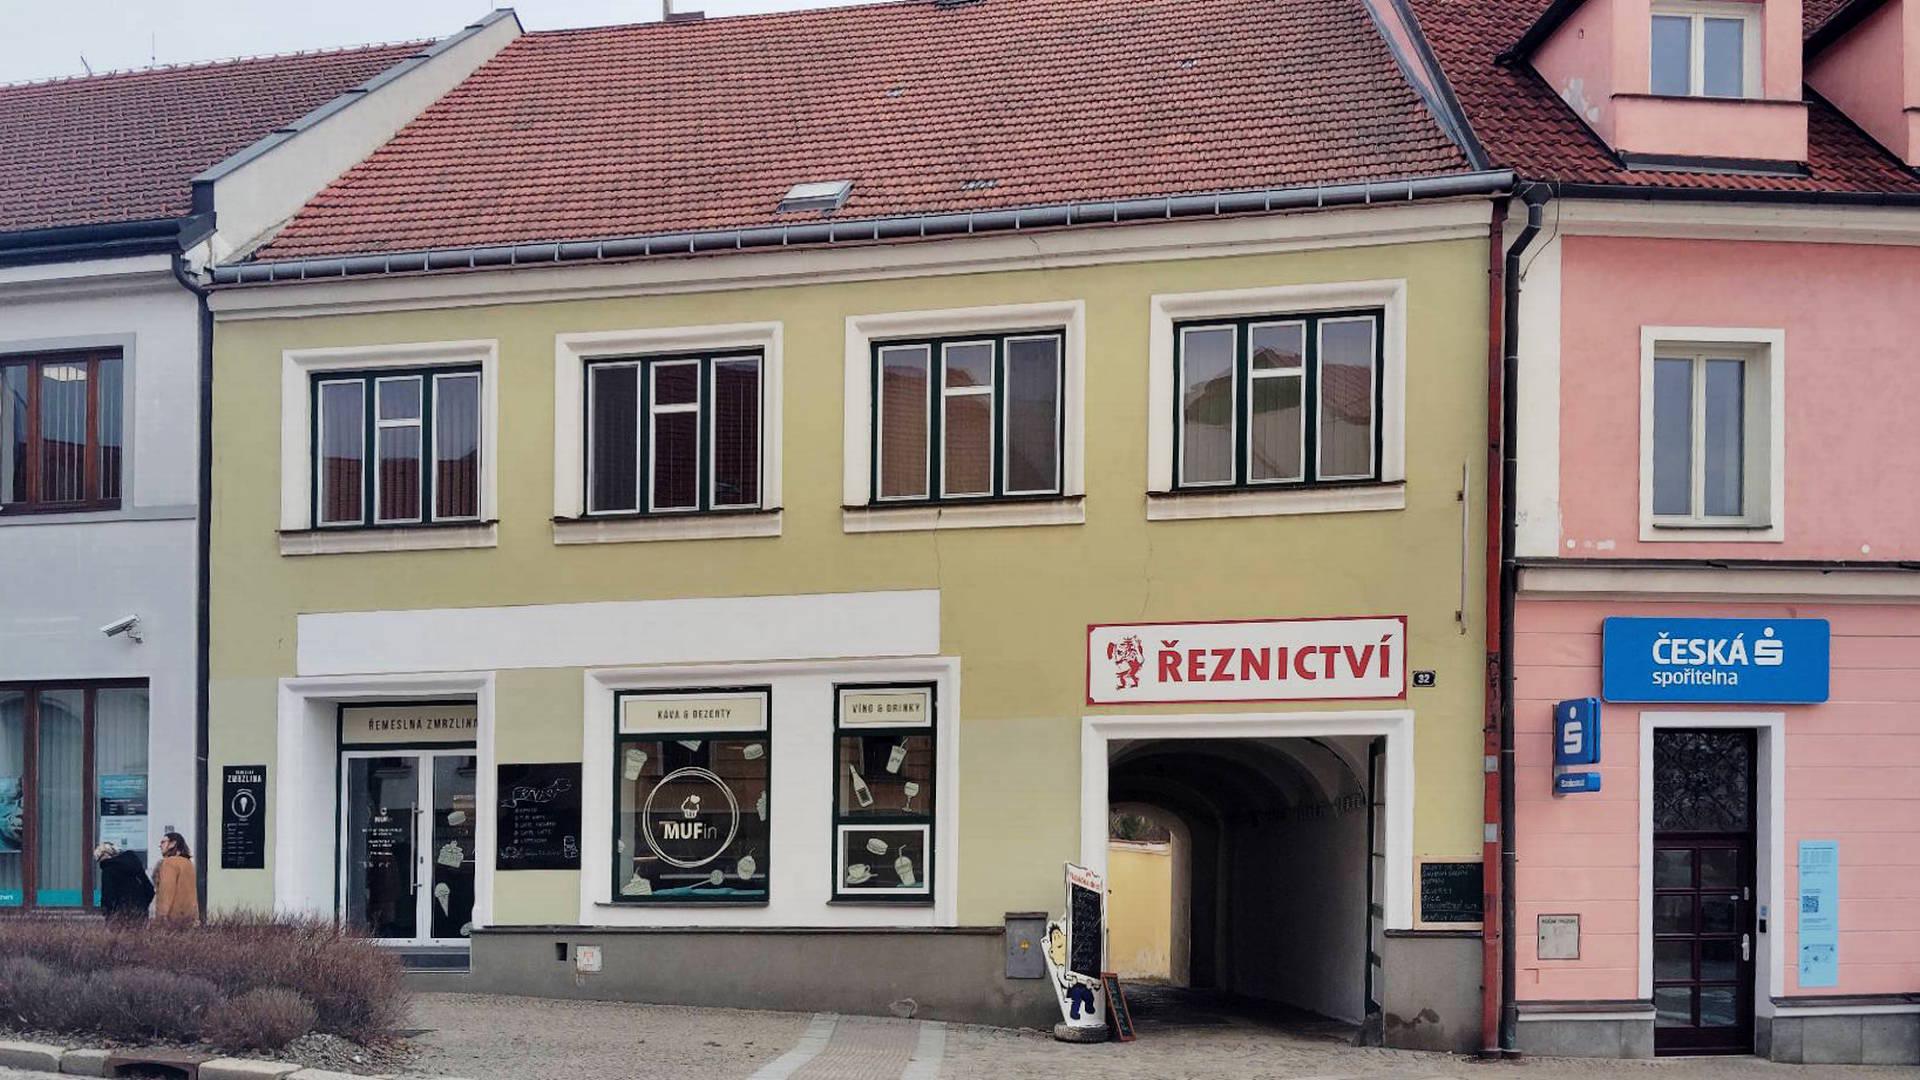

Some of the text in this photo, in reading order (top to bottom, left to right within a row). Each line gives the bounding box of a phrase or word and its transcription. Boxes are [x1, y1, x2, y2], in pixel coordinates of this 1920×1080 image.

[1652, 631, 1749, 666] ČESKÁ
[1158, 634, 1393, 682] ŘEZNICTVÍ
[1418, 674, 1430, 684] 32
[1652, 668, 1738, 687] spořitelna
[886, 703, 920, 713] DRINKY
[368, 717, 422, 731] ŘEMESLNÁ
[663, 822, 717, 840] MUFin
